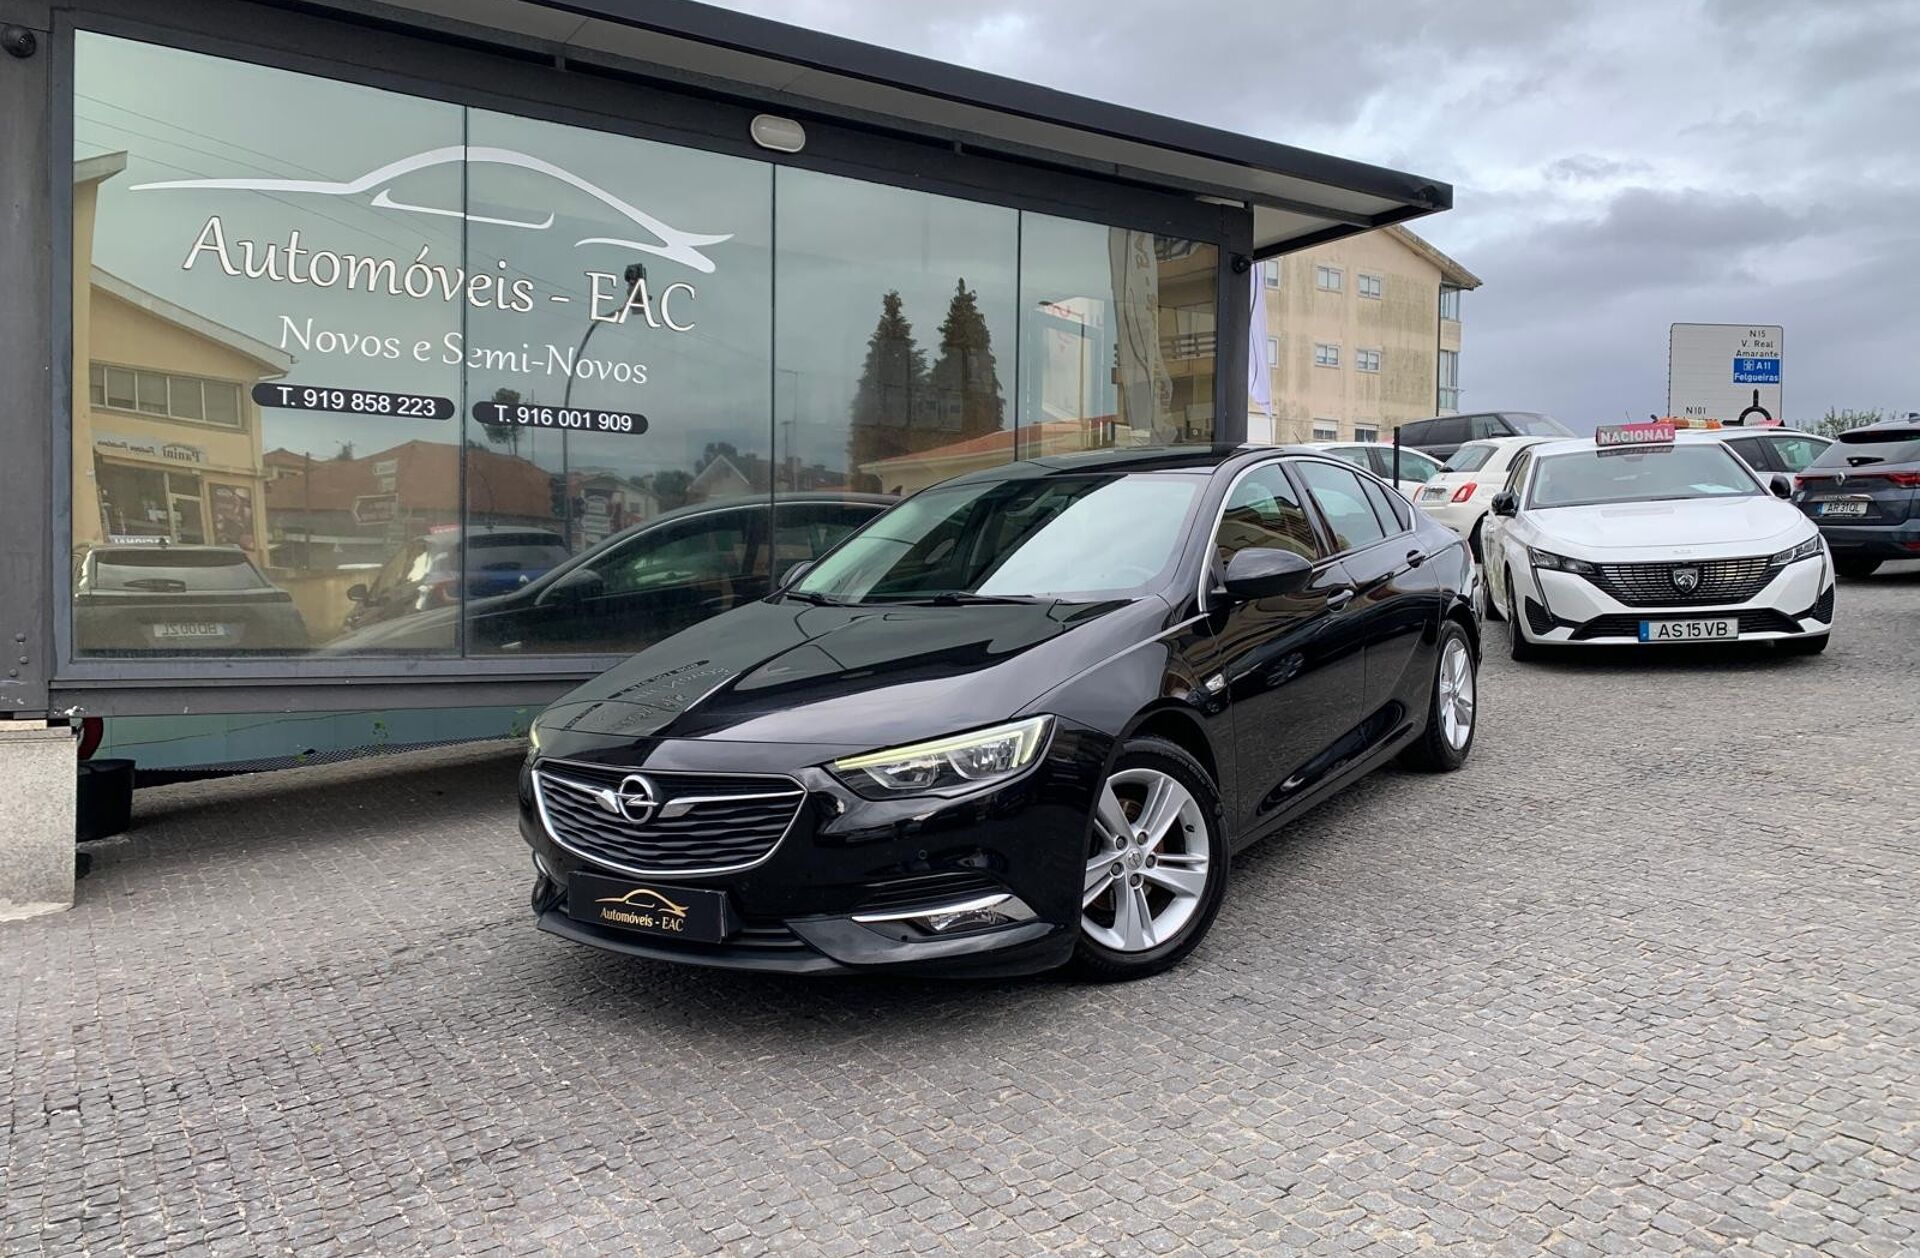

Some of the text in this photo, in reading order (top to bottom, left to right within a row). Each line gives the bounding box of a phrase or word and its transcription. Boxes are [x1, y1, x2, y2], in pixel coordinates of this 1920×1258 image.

[182, 215, 696, 332] Automóveis - EAC
[278, 315, 648, 384] Novos e Semi-Novos
[1754, 340, 1774, 348] Real
[1736, 349, 1779, 358] Amarante
[1756, 361, 1771, 370] A11
[1734, 372, 1779, 382] Felgueiras
[276, 386, 436, 417] T. 919 858 223
[494, 404, 632, 431] T. 916 001 909
[1686, 406, 1706, 415] N101
[1601, 428, 1673, 444] NACIONAL
[601, 907, 653, 927] Automóveis
[662, 916, 684, 932] EAC
